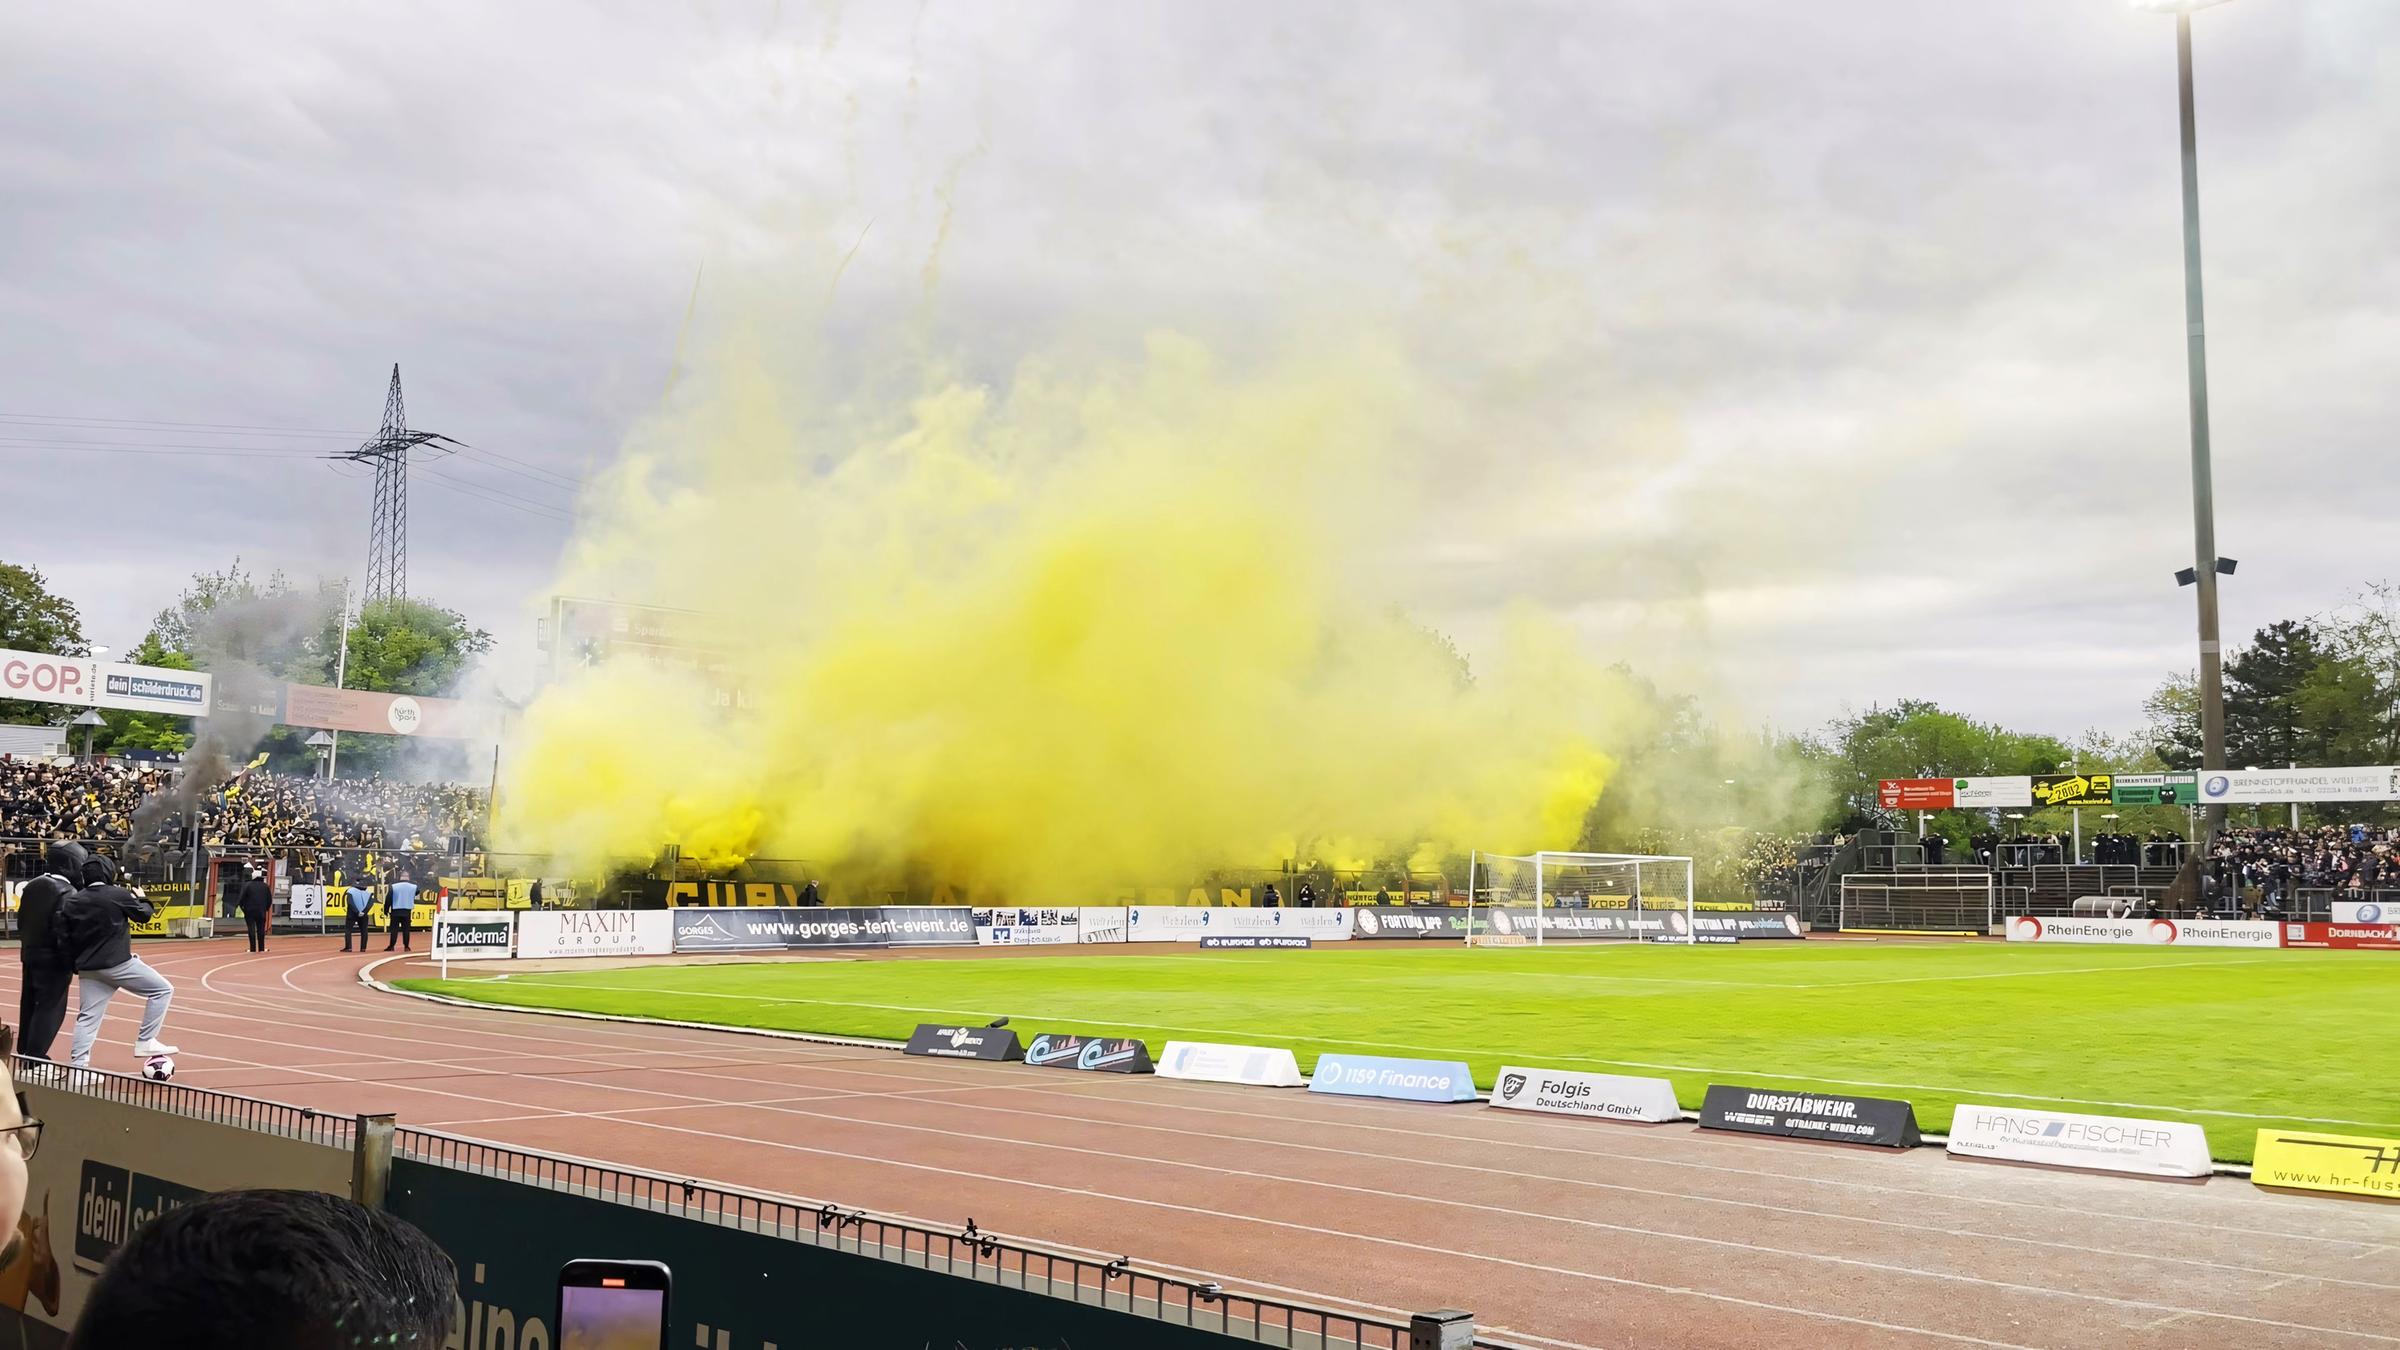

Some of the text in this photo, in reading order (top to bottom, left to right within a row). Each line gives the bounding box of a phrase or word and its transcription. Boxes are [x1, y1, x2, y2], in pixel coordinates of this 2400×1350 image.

[3, 660, 83, 696] GOP.
[109, 677, 201, 700] dein schilderdruck.de
[560, 912, 636, 934] MAXIM
[678, 926, 714, 936] GORGES
[747, 918, 969, 939] www.gorges-tent-event.de
[2047, 925, 2134, 938] RheinEnergie
[558, 935, 637, 945] GROUP
[2182, 927, 2273, 940] RheinEnergie
[1345, 1066, 1451, 1090] 1159 Finance
[1540, 1080, 1591, 1099] Folgis
[1536, 1098, 1642, 1115] Deutschland GmbH
[1747, 1094, 1858, 1119] DURSTABWEHR.
[1724, 1111, 1776, 1127] WEBER
[1785, 1118, 1876, 1137] GETRAENKE-WEBER.COM
[1975, 1114, 2172, 1148] HANS FISCHER
[82, 1177, 121, 1245] dein
